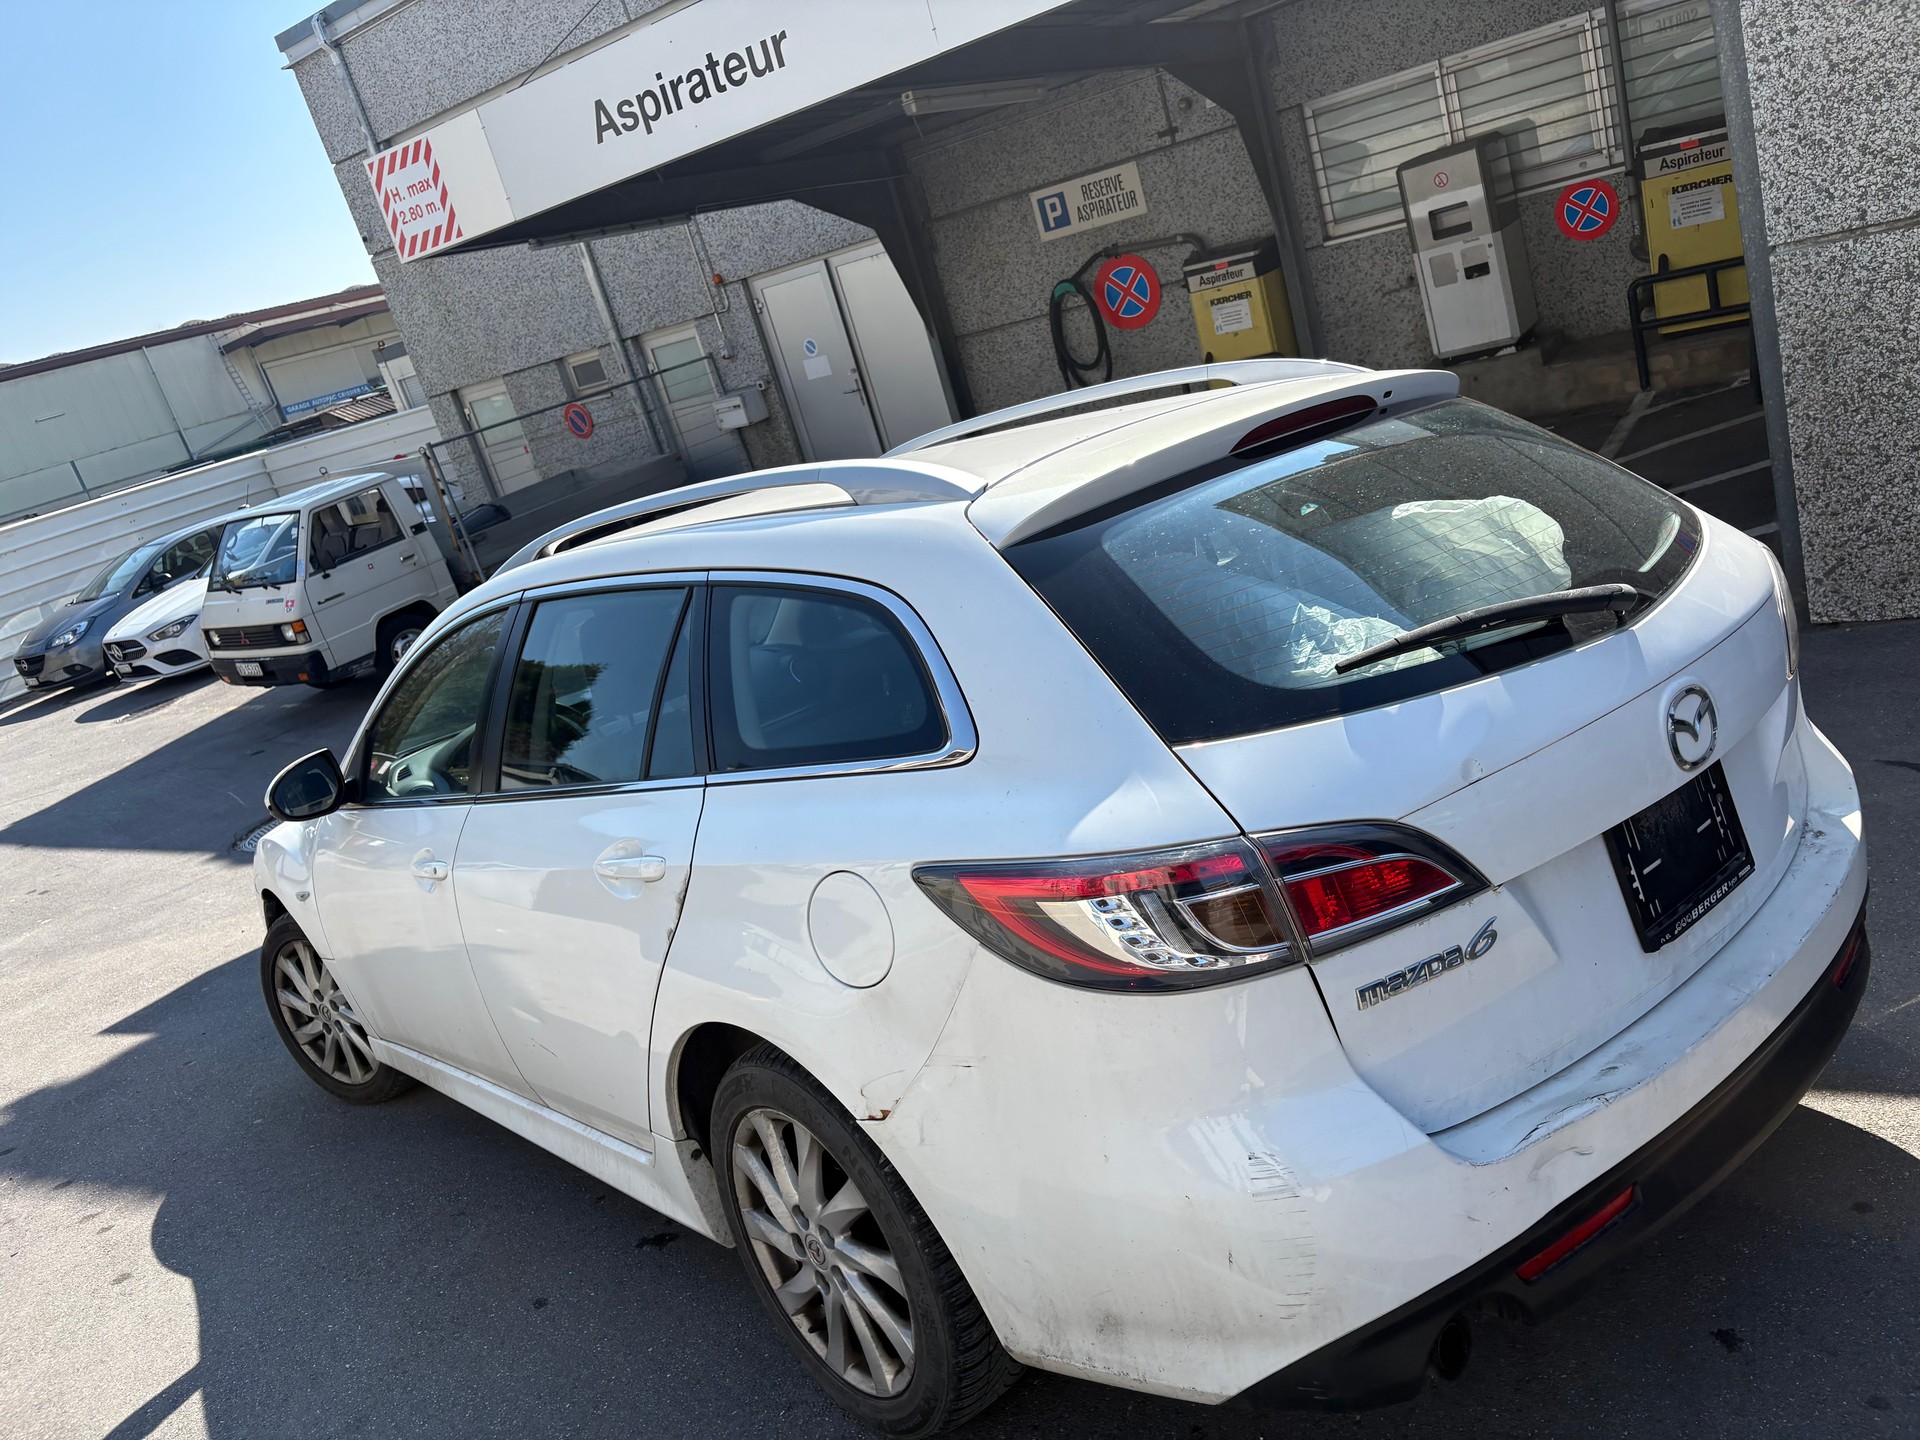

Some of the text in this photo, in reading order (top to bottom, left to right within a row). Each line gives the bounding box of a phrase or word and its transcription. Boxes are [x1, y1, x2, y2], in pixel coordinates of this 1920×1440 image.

[593, 29, 788, 145] Aspirateur
[1660, 146, 1726, 171] Aspirateur
[390, 177, 433, 204] H. max
[1081, 173, 1125, 202] RESERVE
[399, 201, 441, 226] 2.80 m.
[1044, 196, 1063, 229] P
[1076, 190, 1139, 223] ASPIRATEUR
[1199, 269, 1245, 287] Aspirateur
[1691, 882, 1729, 920] BERGER
